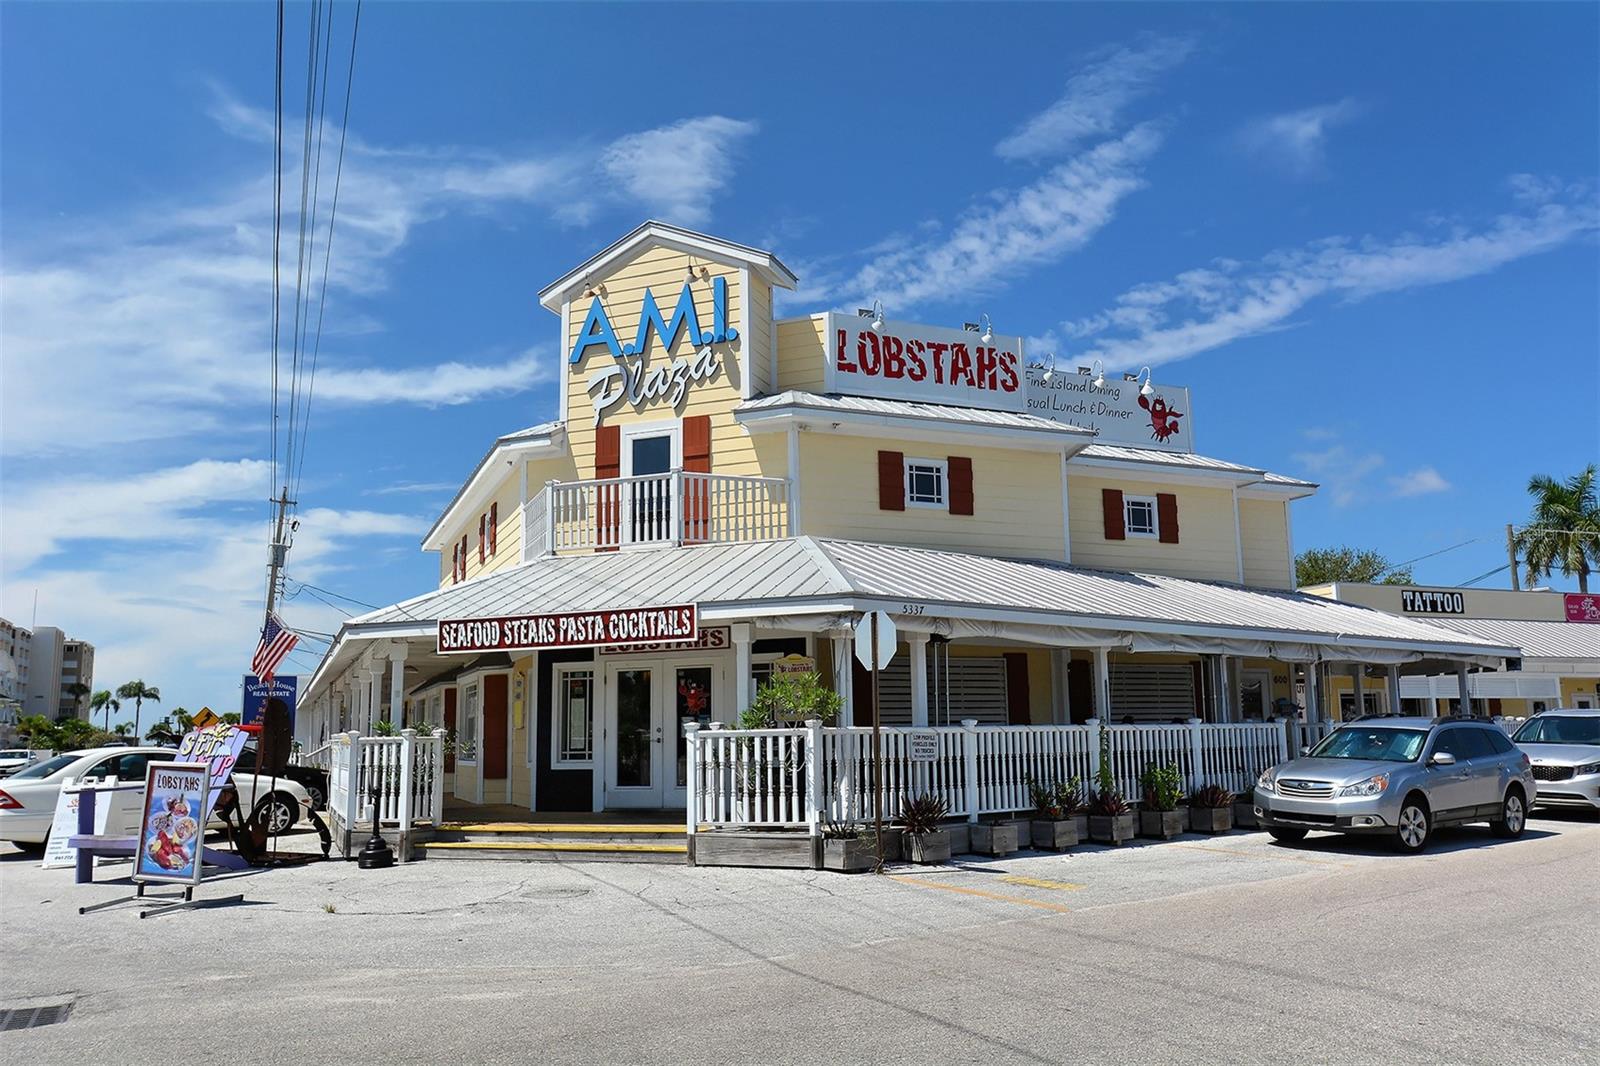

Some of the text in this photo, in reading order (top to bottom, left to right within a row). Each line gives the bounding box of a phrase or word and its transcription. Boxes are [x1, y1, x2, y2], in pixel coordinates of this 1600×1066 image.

[569, 276, 739, 364] A.M.I.
[837, 328, 1020, 393] LOBSTAHS
[587, 347, 720, 427] Plaza
[1053, 394, 1087, 415] Lunch
[1098, 402, 1134, 419] Dinner
[902, 604, 925, 615] 5337
[1402, 591, 1463, 613] TATTOO
[441, 620, 500, 648] SEAFOOD
[504, 615, 556, 645] STEAKS
[559, 614, 605, 643] PASTA
[609, 608, 691, 640] COCKTAILS
[272, 680, 296, 692] House
[157, 774, 200, 791] LOBSTAHS
